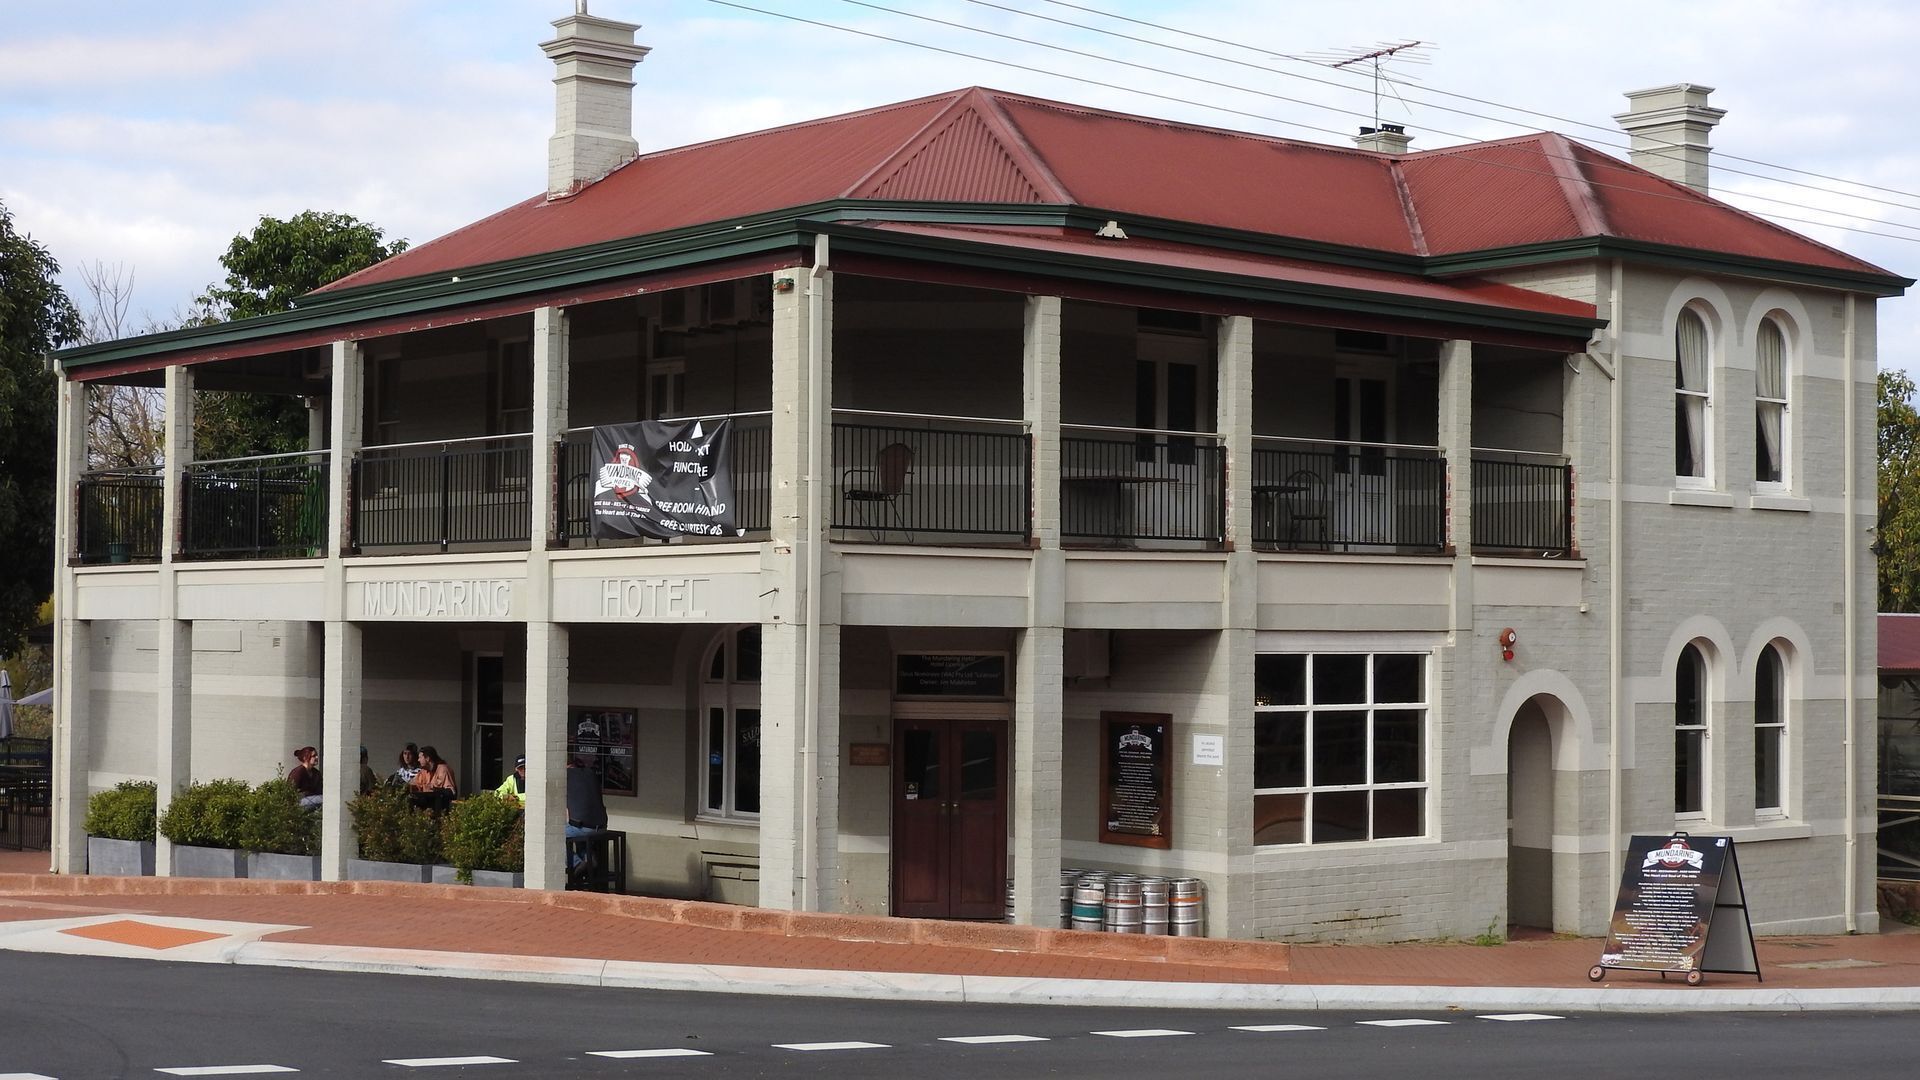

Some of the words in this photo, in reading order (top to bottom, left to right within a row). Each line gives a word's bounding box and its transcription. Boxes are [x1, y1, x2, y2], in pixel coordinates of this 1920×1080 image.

[672, 502, 695, 514] ROOM
[362, 580, 512, 617] MUNDARING
[601, 578, 710, 618] HOTEL
[1655, 850, 1695, 858] MUNDARING
